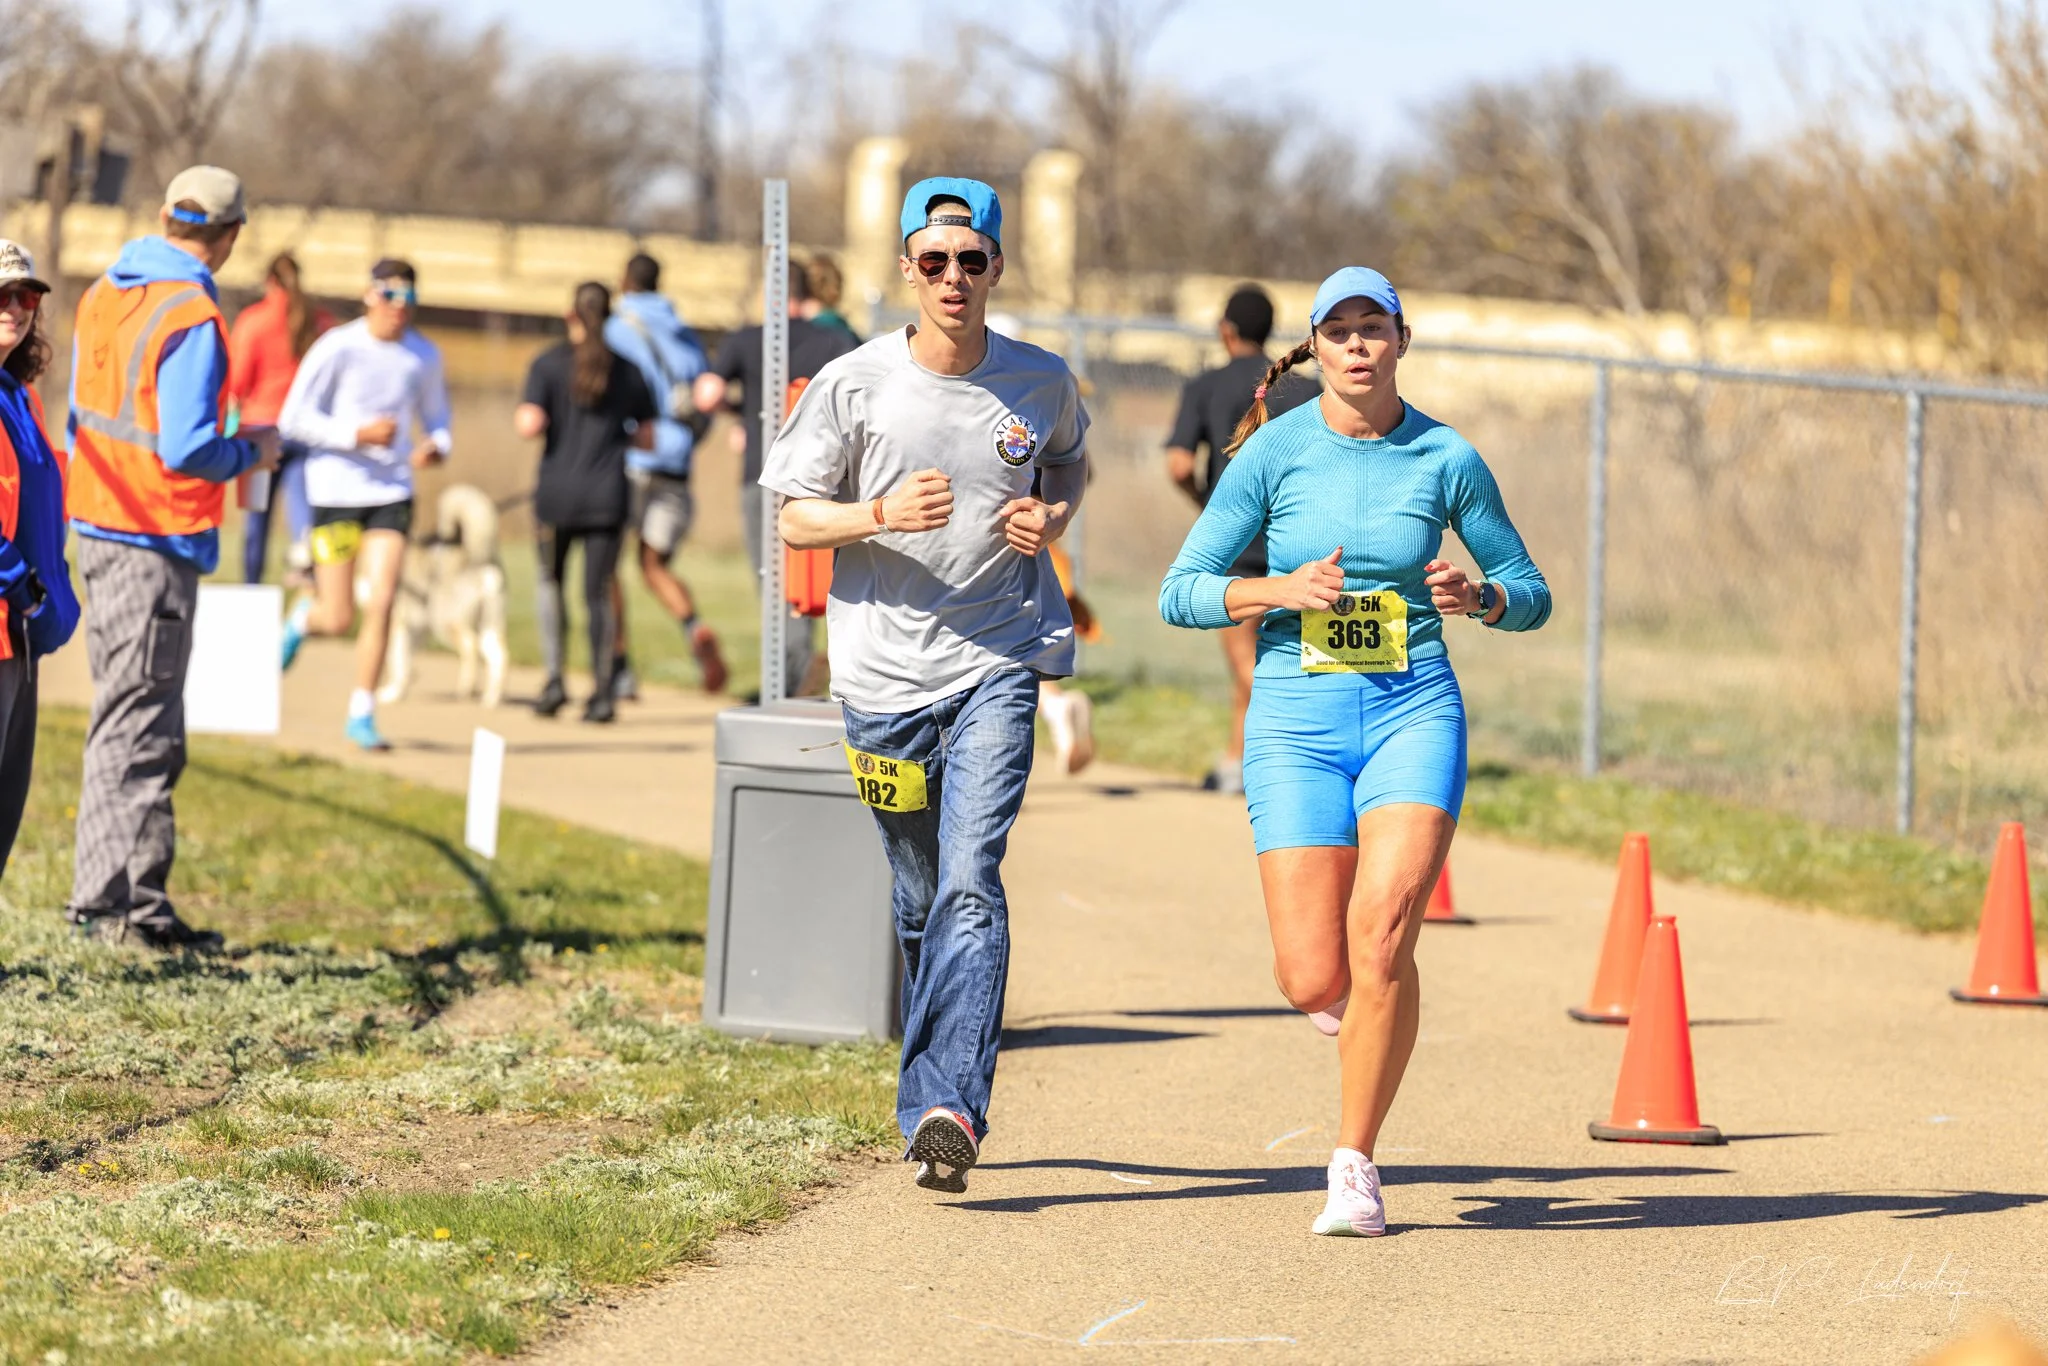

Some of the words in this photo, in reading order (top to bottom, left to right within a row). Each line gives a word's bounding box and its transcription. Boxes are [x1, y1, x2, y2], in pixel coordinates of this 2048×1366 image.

[997, 417, 1034, 439] ALASKA
[1361, 596, 1381, 612] 5K
[1327, 619, 1380, 649] 363
[879, 760, 899, 777] 5K
[857, 777, 898, 807] 182
